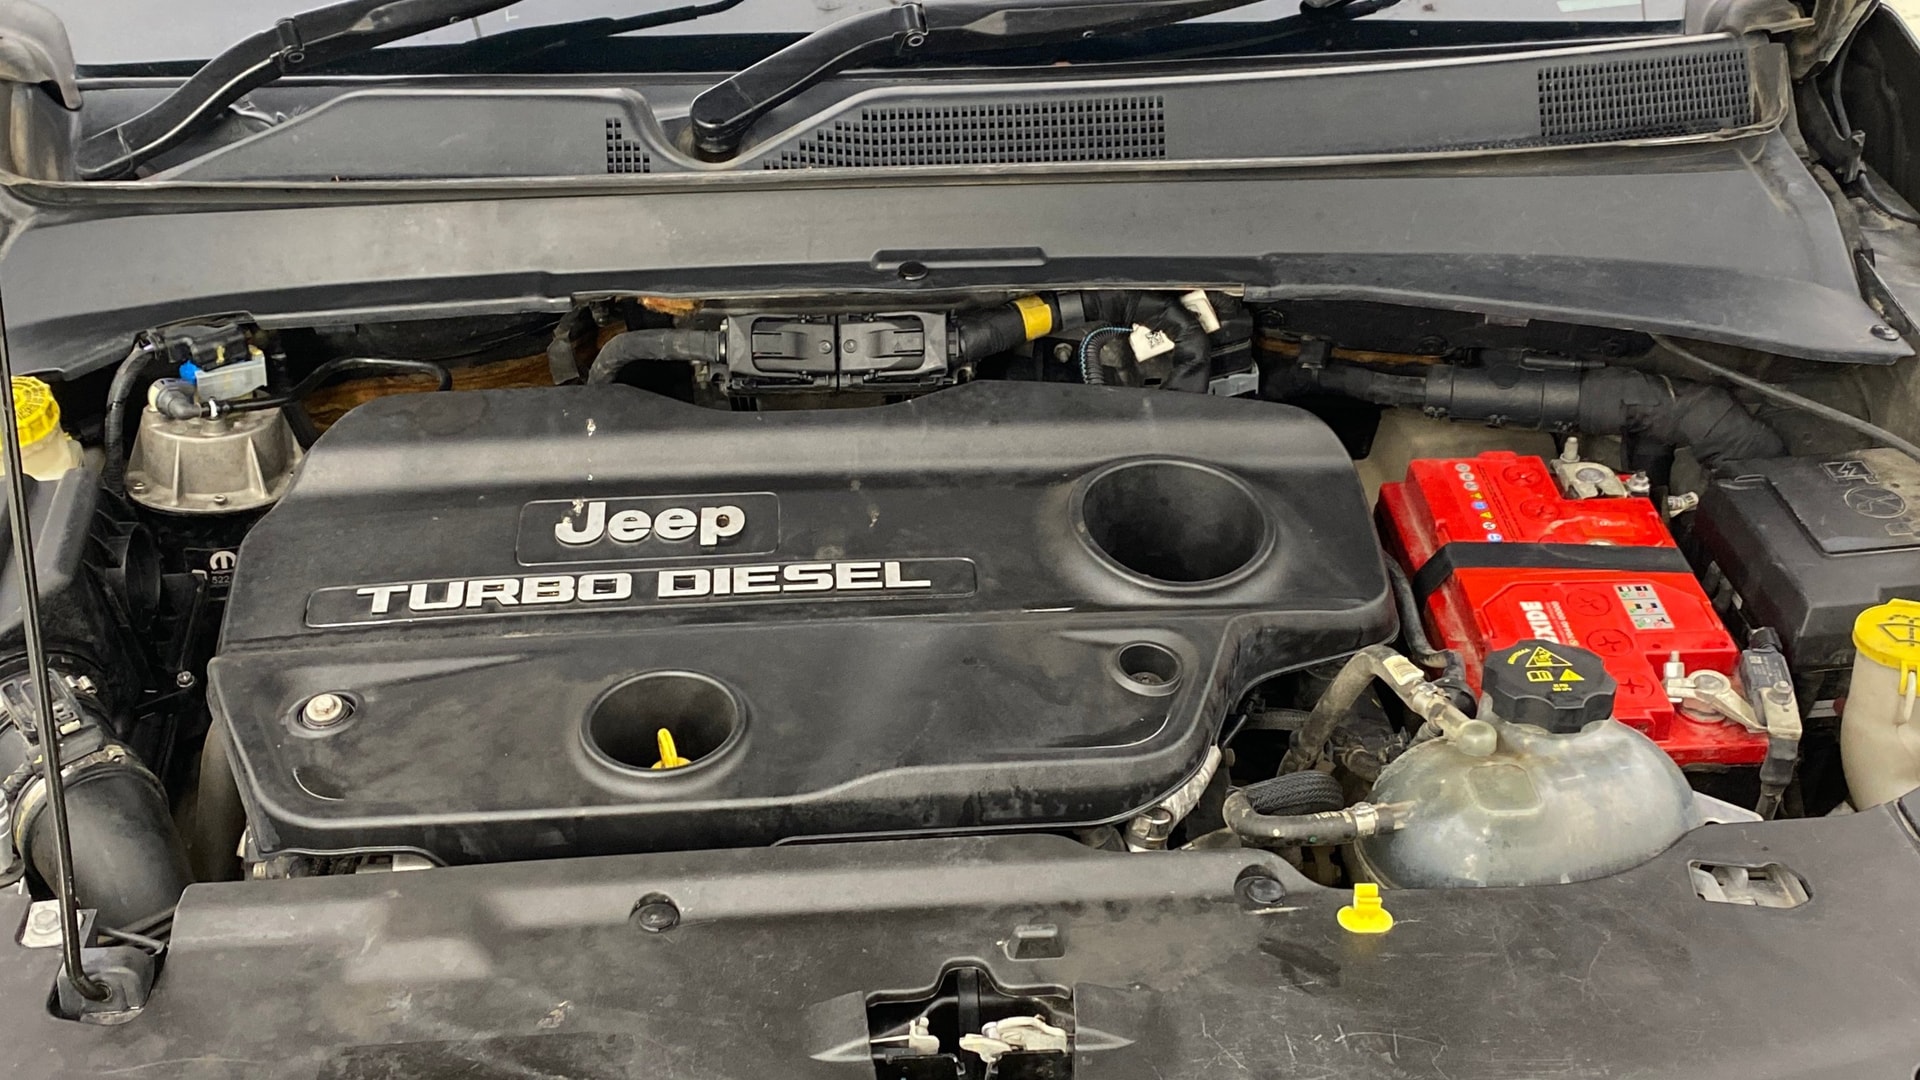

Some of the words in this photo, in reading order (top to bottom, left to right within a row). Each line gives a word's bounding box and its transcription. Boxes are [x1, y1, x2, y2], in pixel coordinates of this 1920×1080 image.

[554, 501, 746, 546] Jeep
[357, 572, 633, 613] TURBO
[657, 561, 932, 598] DIESEL
